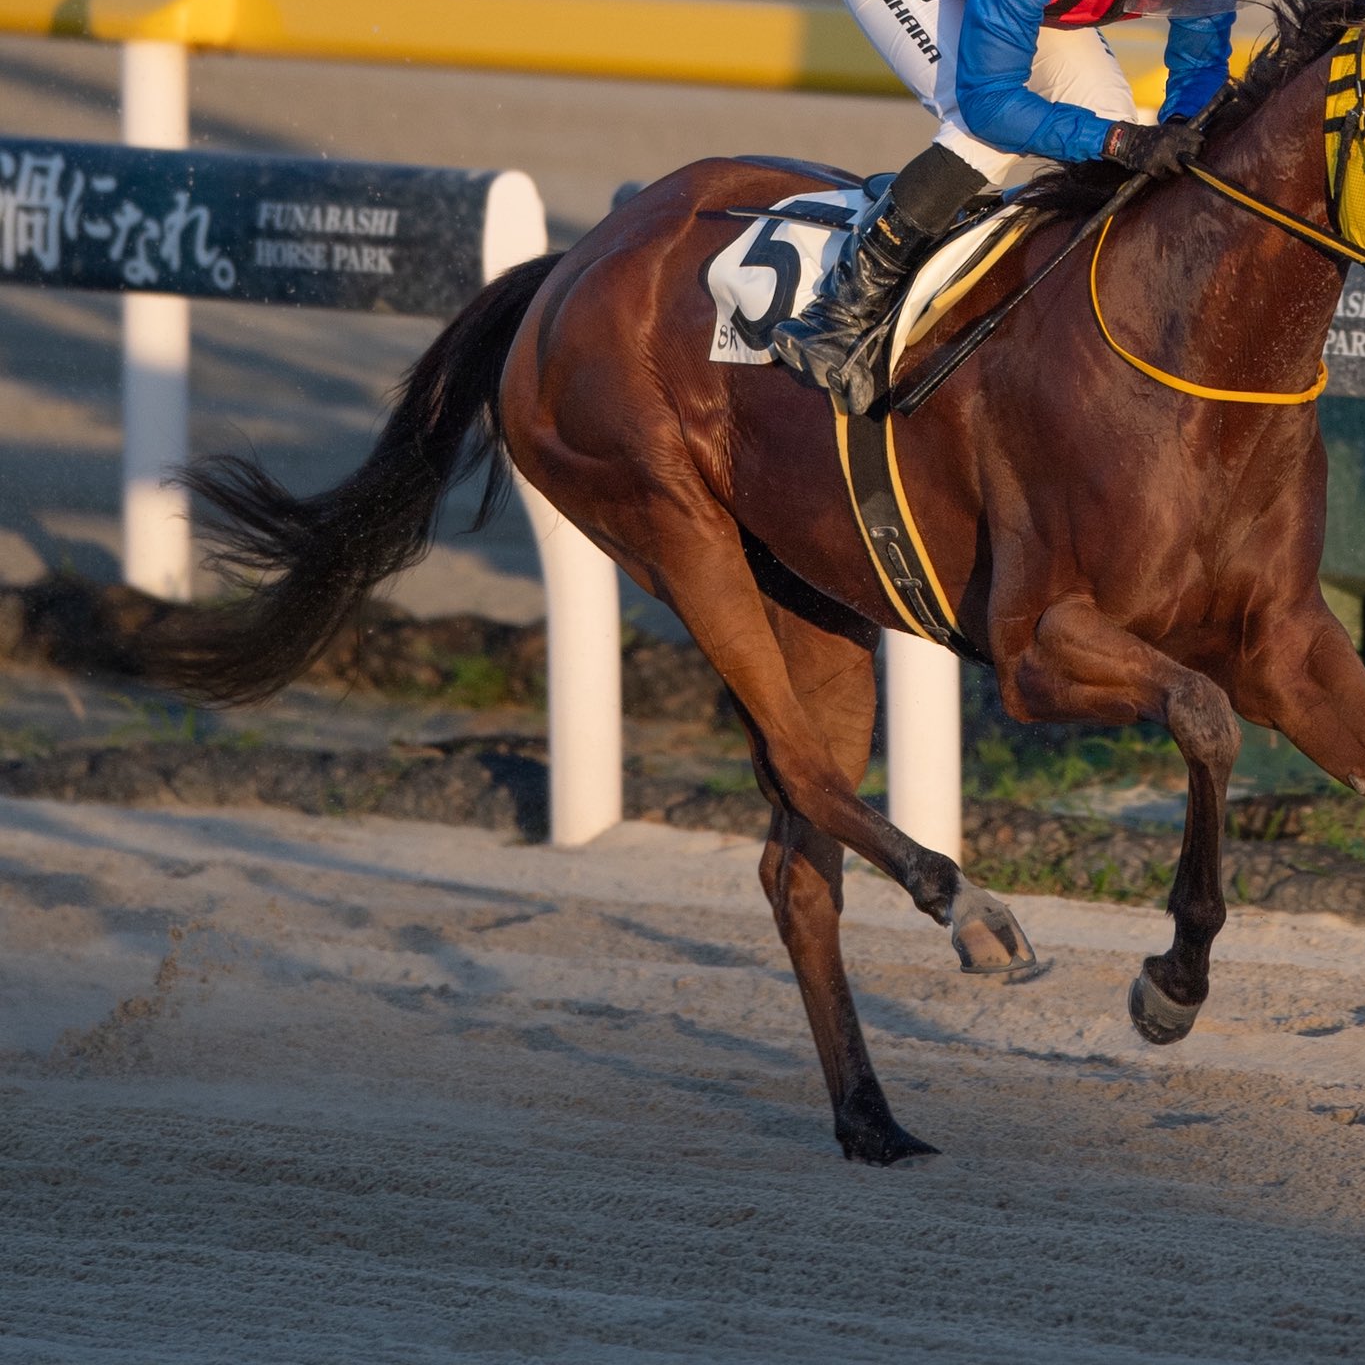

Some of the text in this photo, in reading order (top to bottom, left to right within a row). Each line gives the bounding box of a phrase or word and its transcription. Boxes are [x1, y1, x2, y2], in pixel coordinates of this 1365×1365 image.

[256, 202, 400, 237] FUNABASHI
[254, 238, 395, 275] HORSE PARK
[729, 199, 859, 352] 5
